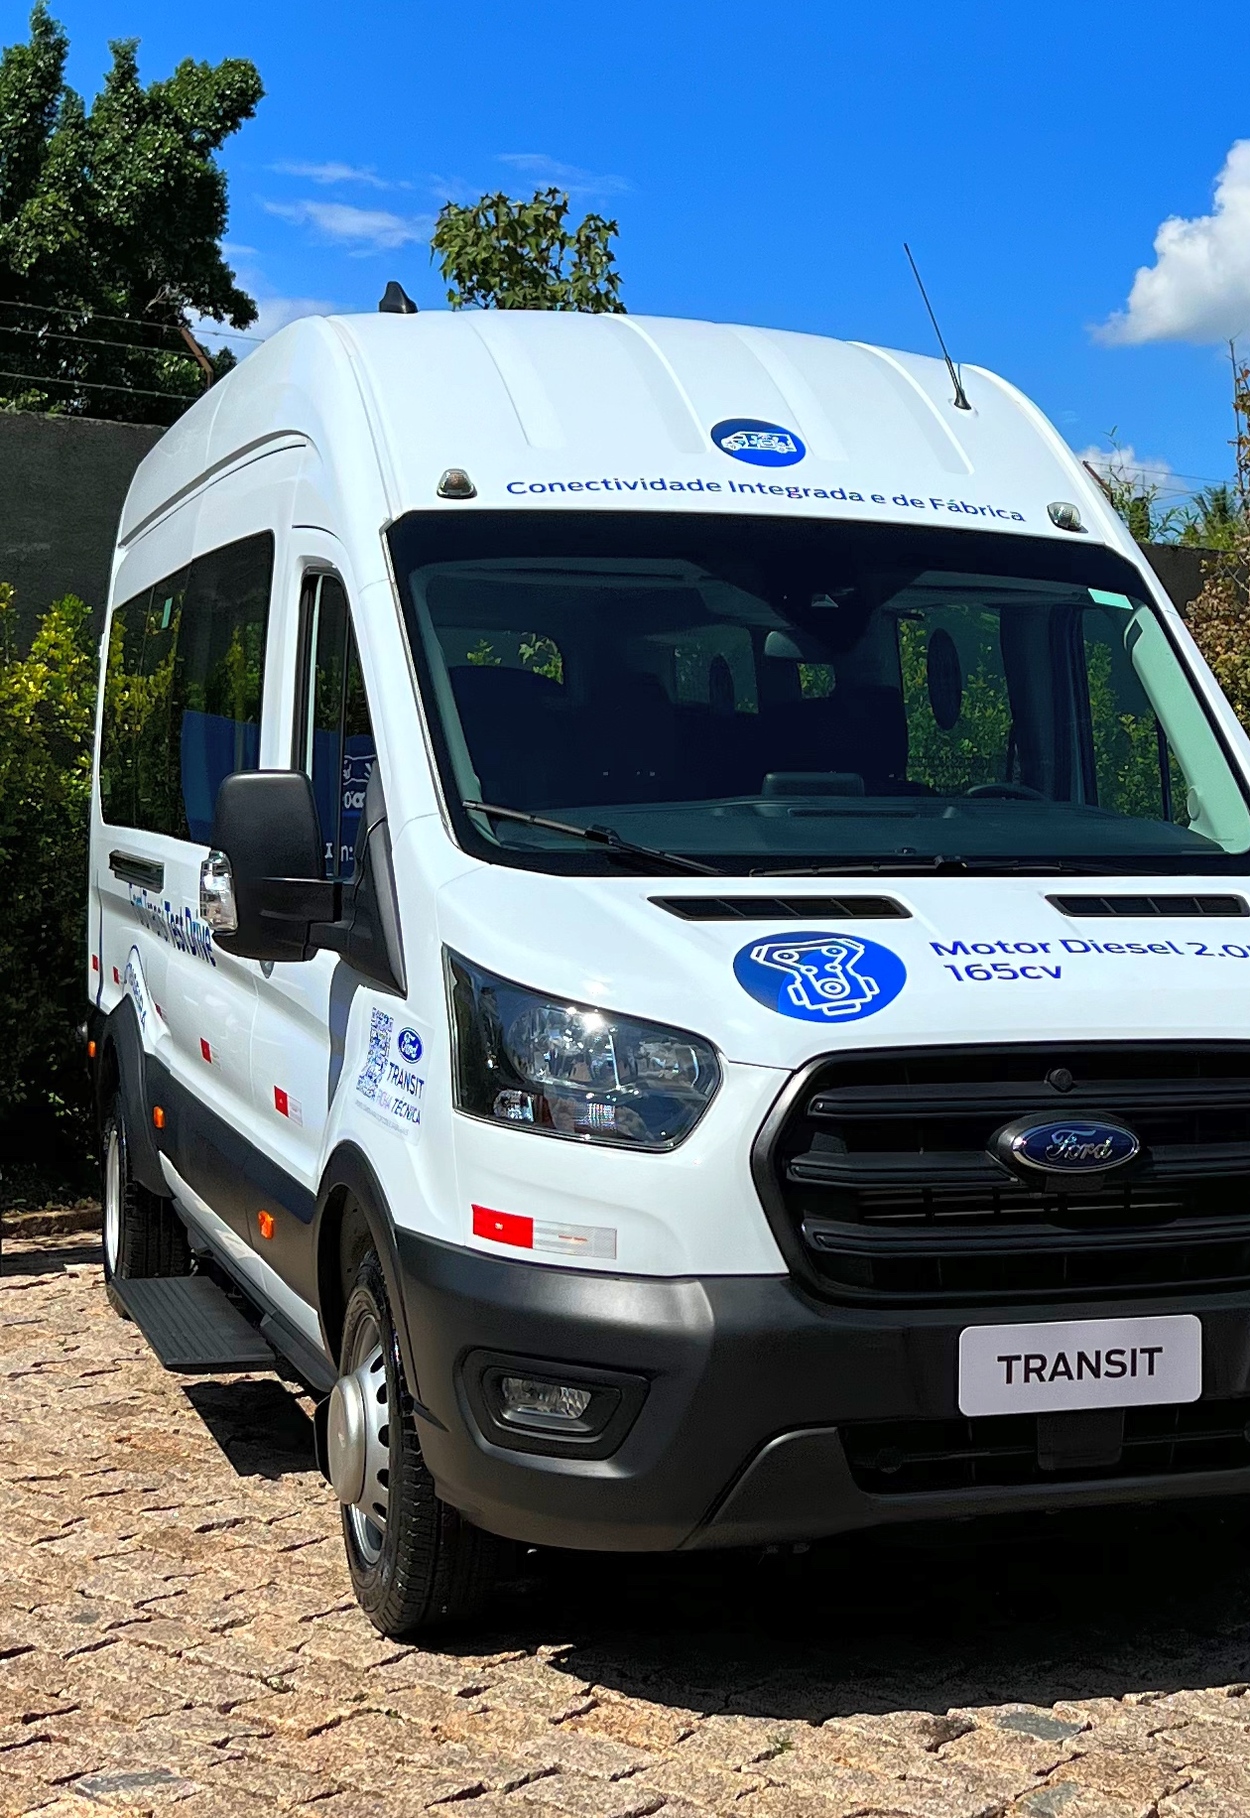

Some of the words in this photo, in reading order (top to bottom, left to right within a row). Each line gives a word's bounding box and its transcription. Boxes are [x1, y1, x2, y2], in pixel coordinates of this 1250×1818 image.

[506, 477, 723, 495] Conectividade
[727, 480, 865, 503] Integrada
[871, 492, 887, 505] e
[892, 493, 926, 509] de
[930, 496, 1027, 522] Fábrica
[929, 940, 1051, 956] Motor
[1059, 939, 1186, 956] Diesel
[943, 962, 1062, 982] 165cv
[386, 1061, 425, 1100] TRANSIT
[391, 1095, 421, 1126] TÉCNICA
[1045, 1128, 1114, 1161] Ford
[997, 1346, 1164, 1385] TRANSIT
